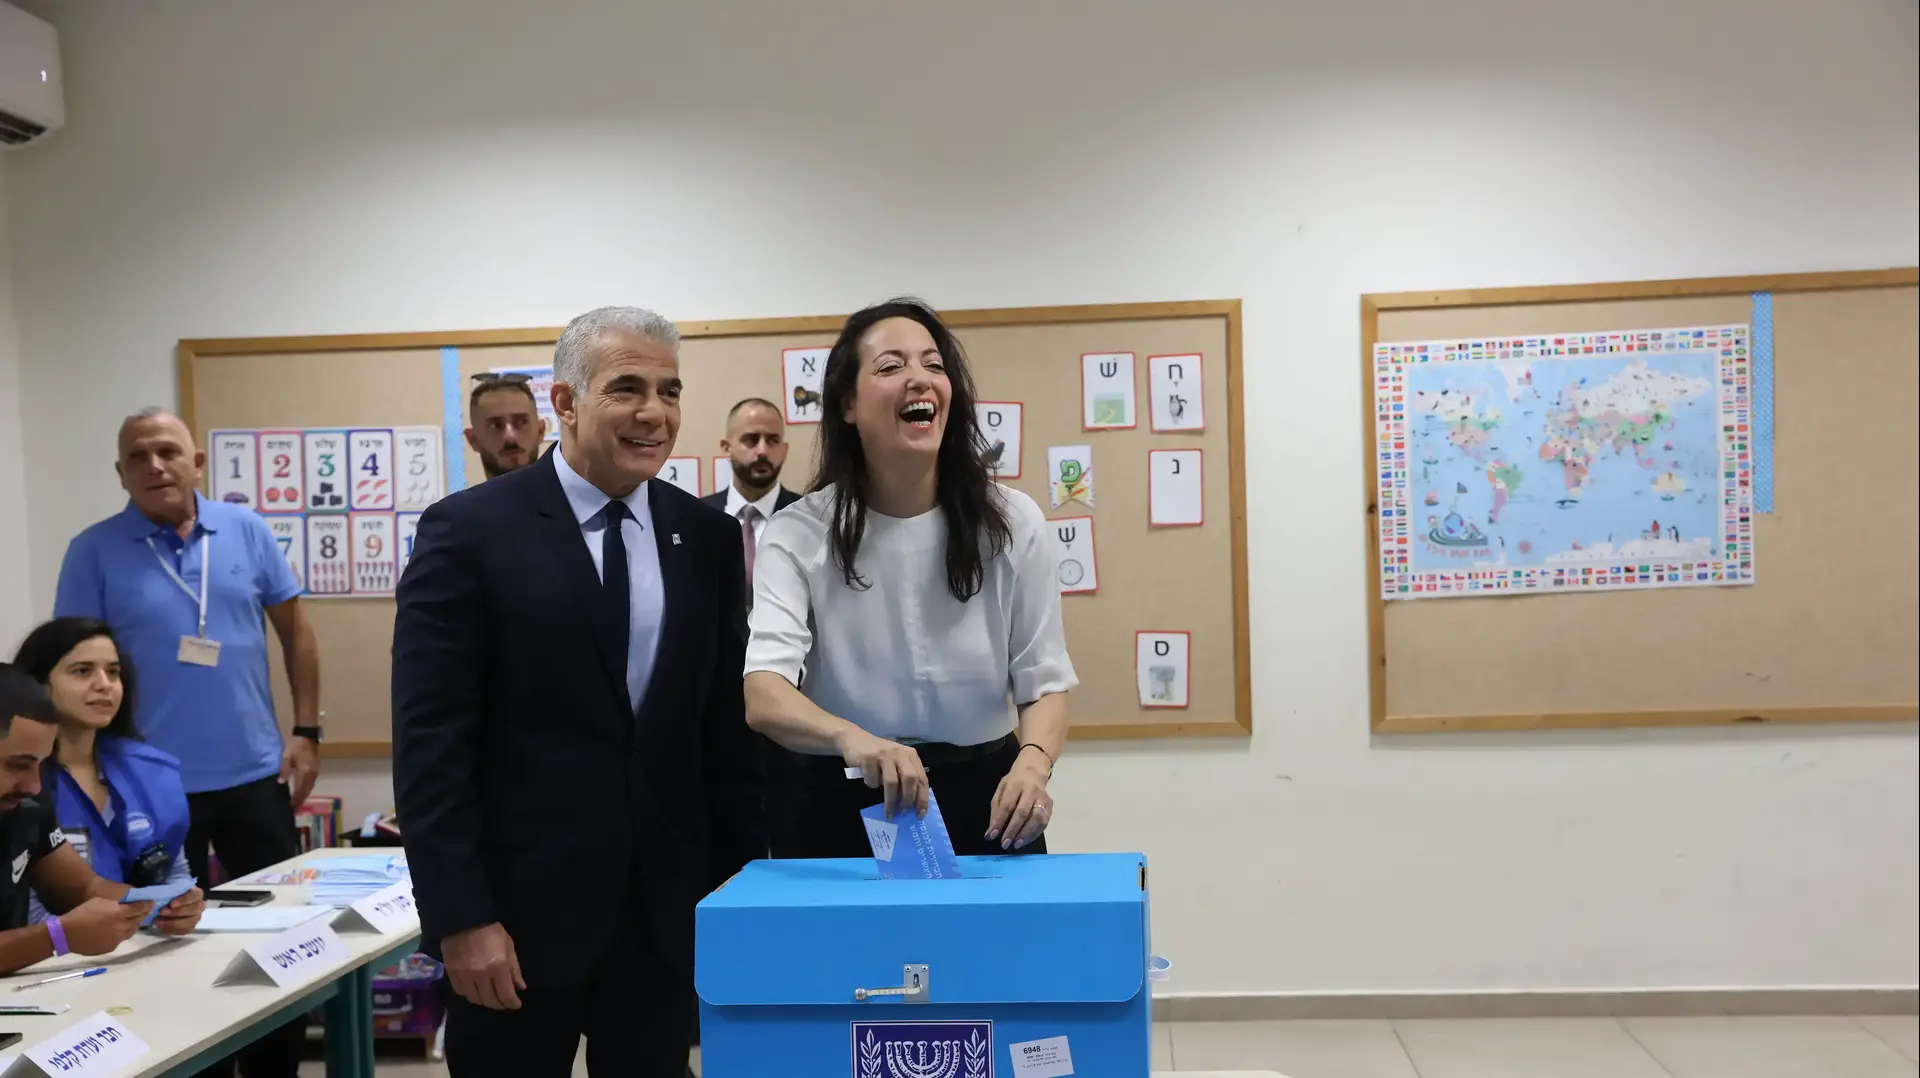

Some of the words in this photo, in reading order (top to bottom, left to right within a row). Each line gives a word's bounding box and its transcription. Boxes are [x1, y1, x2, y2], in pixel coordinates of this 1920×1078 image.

[230, 456, 242, 479] 1
[273, 454, 291, 478] 2
[318, 453, 335, 477] 3
[361, 452, 379, 476] 4
[409, 453, 426, 476] 5
[669, 466, 678, 481] ג
[277, 537, 293, 557] 7
[320, 535, 338, 559] 8
[365, 534, 382, 558] 9
[272, 948, 303, 969] ראש
[299, 936, 326, 958] יושב
[95, 1026, 124, 1044] חבר
[73, 1036, 104, 1059] ועדת
[1023, 1045, 1041, 1054] 6948
[47, 1049, 83, 1071] קלפי
